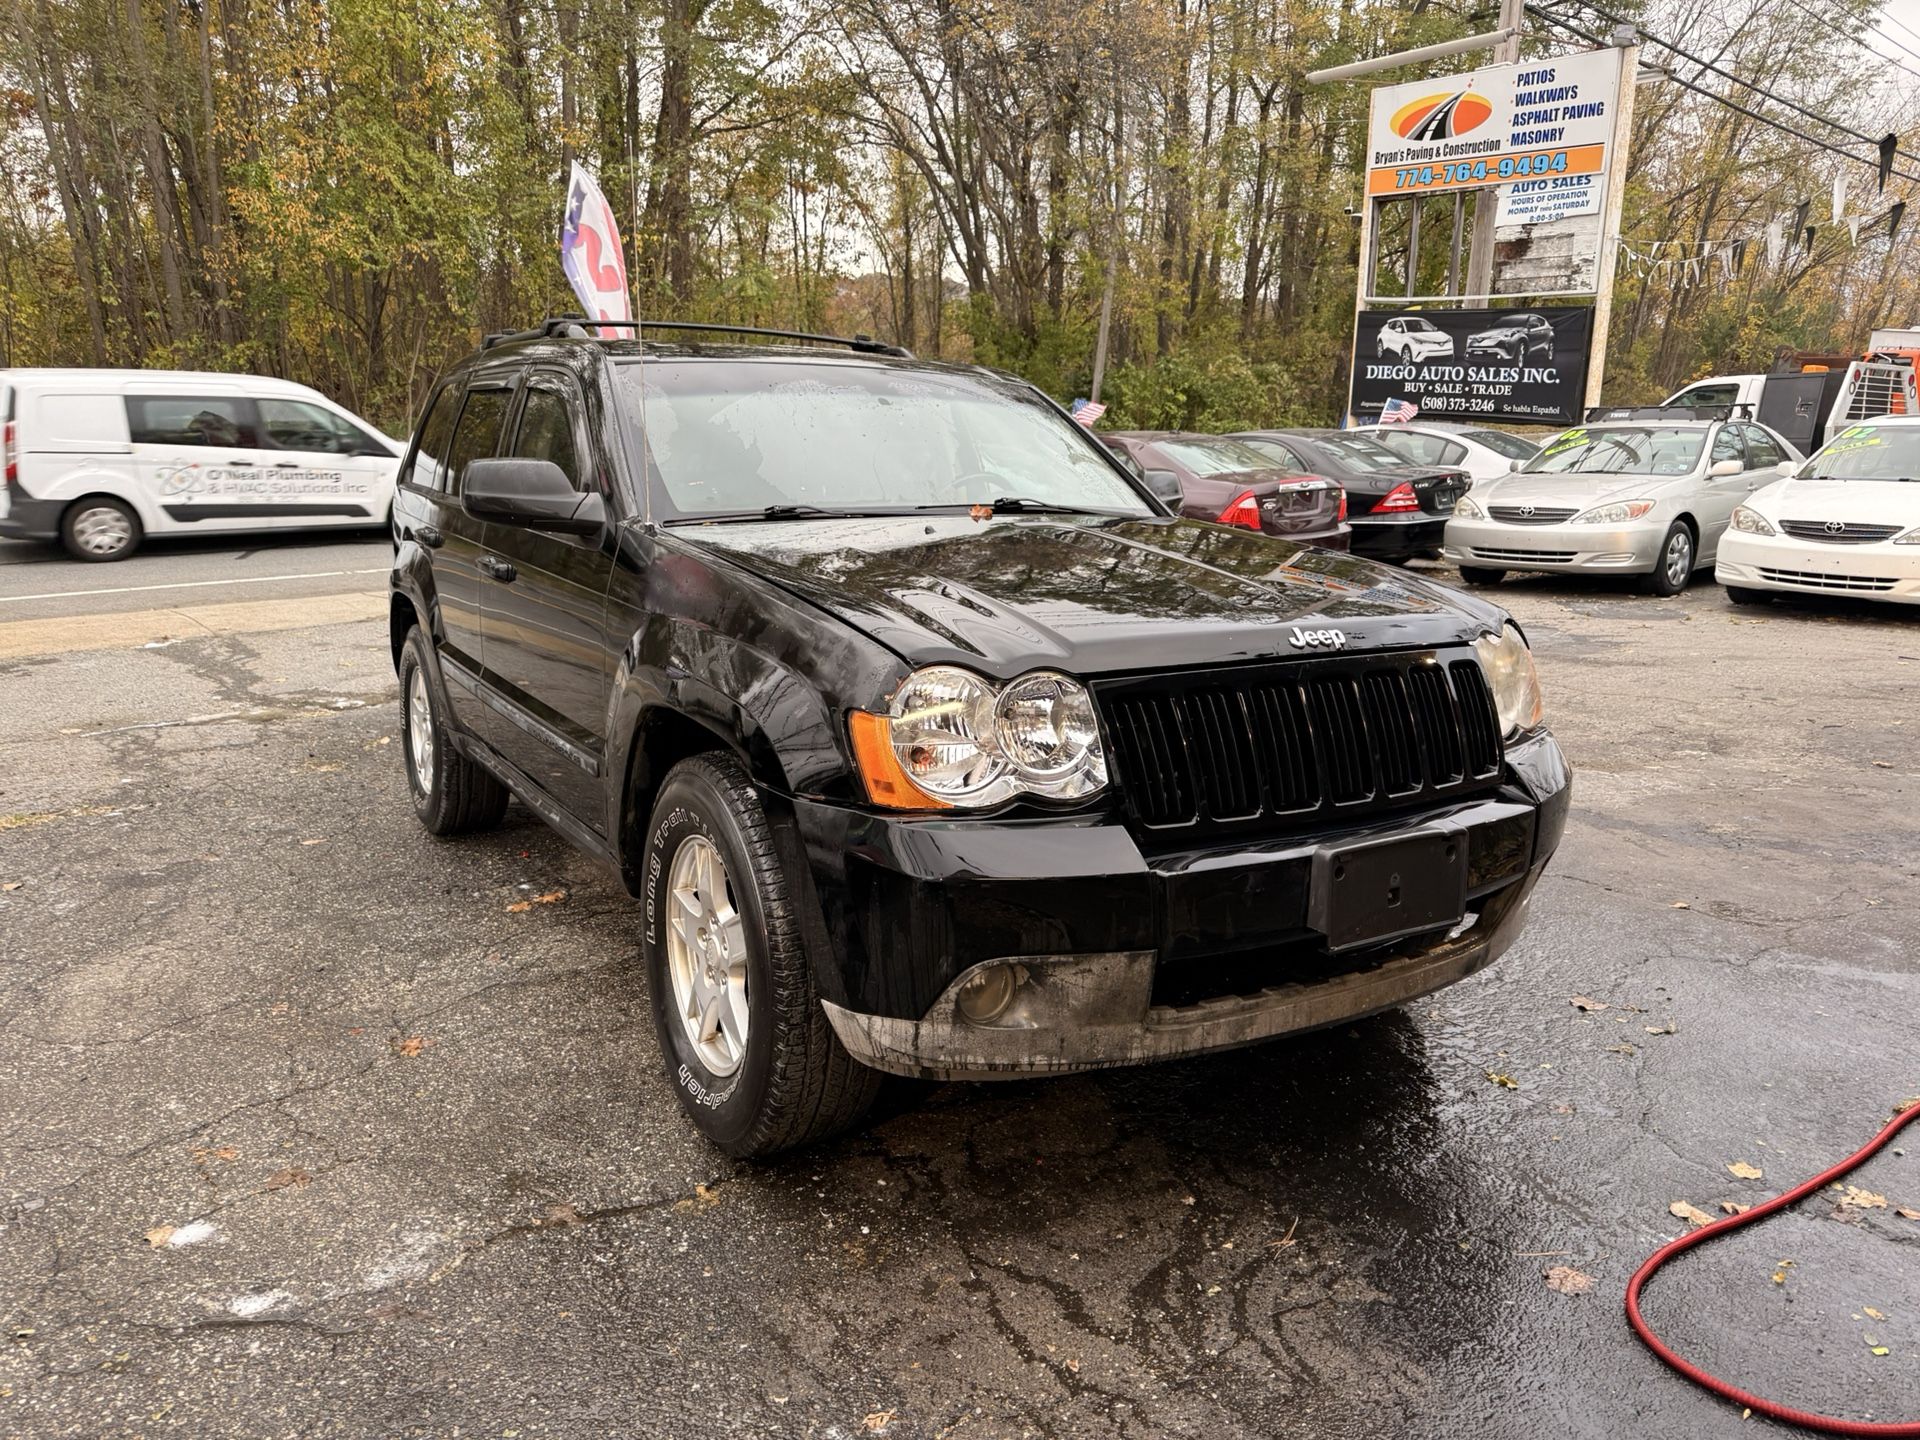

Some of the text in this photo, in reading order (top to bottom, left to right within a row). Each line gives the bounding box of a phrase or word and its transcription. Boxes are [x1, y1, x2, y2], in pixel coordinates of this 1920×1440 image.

[1516, 68, 1556, 87] PATIOS
[1515, 85, 1578, 107] WALKWAYS
[1512, 101, 1605, 127] ASPHALT PAVING
[1510, 127, 1565, 146] MASONRY
[1374, 138, 1501, 165] Bryan's Paving & Construction
[1395, 152, 1568, 189] 774-764-9494
[1511, 174, 1592, 194] AUTO SALES
[1511, 190, 1588, 206] HOURS OF OPERATION
[1507, 205, 1539, 216] MONDAY
[1552, 200, 1590, 211] SATURDAY
[1366, 365, 1560, 384] DIEGO AUTO SALES INC.
[1404, 383, 1512, 396] BUY SALE TRADE
[1421, 395, 1495, 412] (508) 373-3246
[1503, 404, 1560, 415] Se habla Español
[266, 469, 342, 483] Plumbing
[269, 483, 341, 494] Solutions
[1289, 626, 1346, 650] Jeep
[653, 807, 689, 849] Trail
[646, 852, 661, 945] Long
